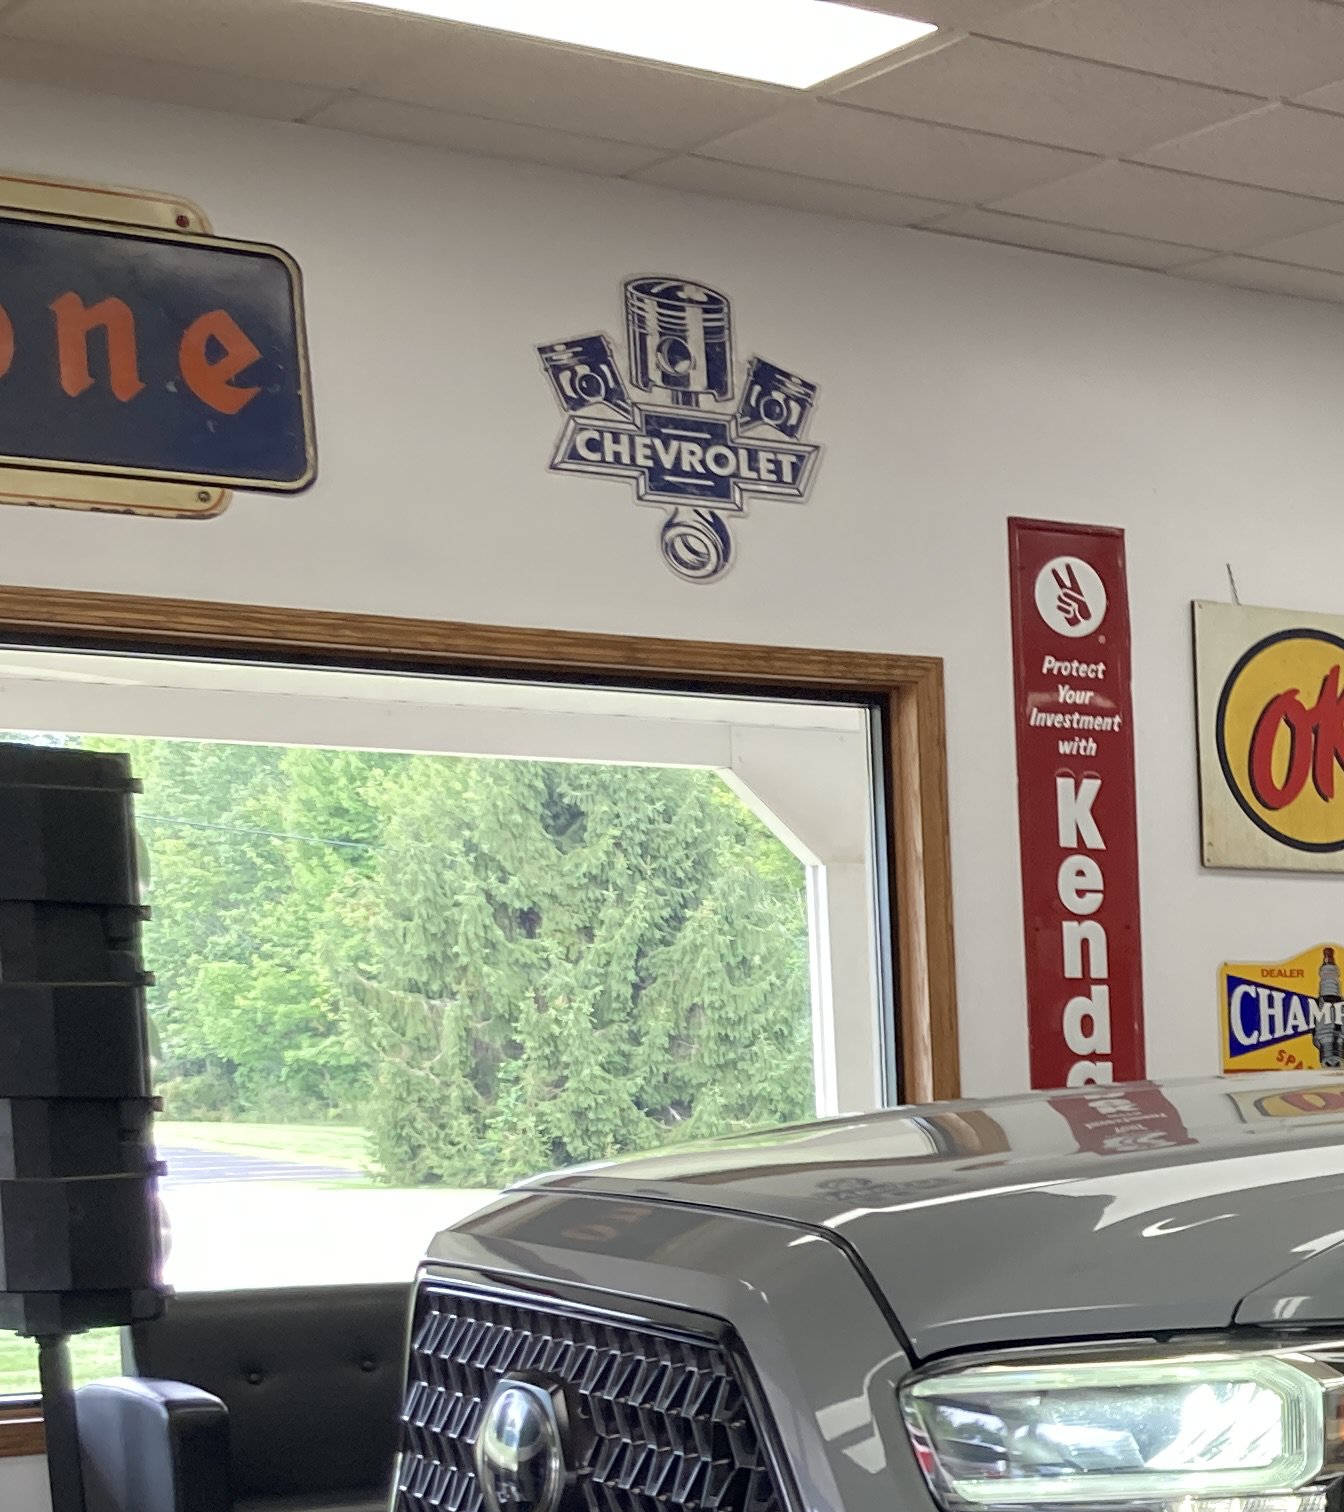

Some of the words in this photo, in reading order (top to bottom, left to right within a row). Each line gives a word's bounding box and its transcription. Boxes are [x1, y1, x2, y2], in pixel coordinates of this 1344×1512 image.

[0, 291, 262, 414] ne
[575, 430, 797, 483] CHEVROLET
[1042, 655, 1106, 679] Protect
[1058, 684, 1094, 704] Your
[1029, 707, 1122, 732] Investment
[1058, 736, 1097, 756] with
[1260, 968, 1304, 978] DEALER
